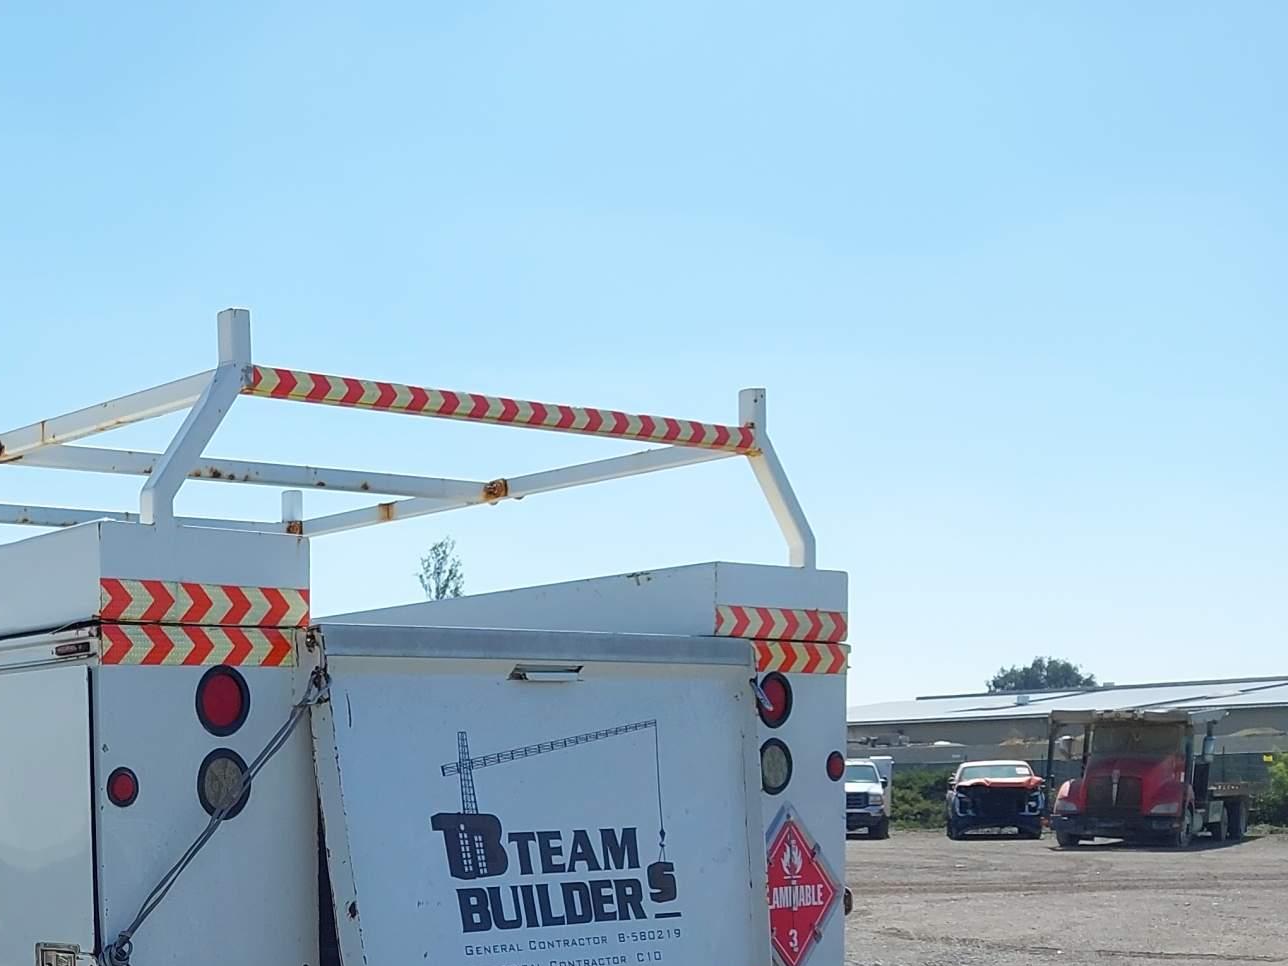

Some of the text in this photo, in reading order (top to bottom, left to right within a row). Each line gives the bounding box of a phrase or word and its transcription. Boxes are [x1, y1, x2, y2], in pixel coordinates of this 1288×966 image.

[508, 827, 641, 875] TEAM
[456, 861, 678, 933] BUILDERS
[768, 884, 824, 911] LAMMABLE
[465, 928, 682, 956] GENERAL CONTRACTOR B-580219
[788, 929, 799, 952] 3
